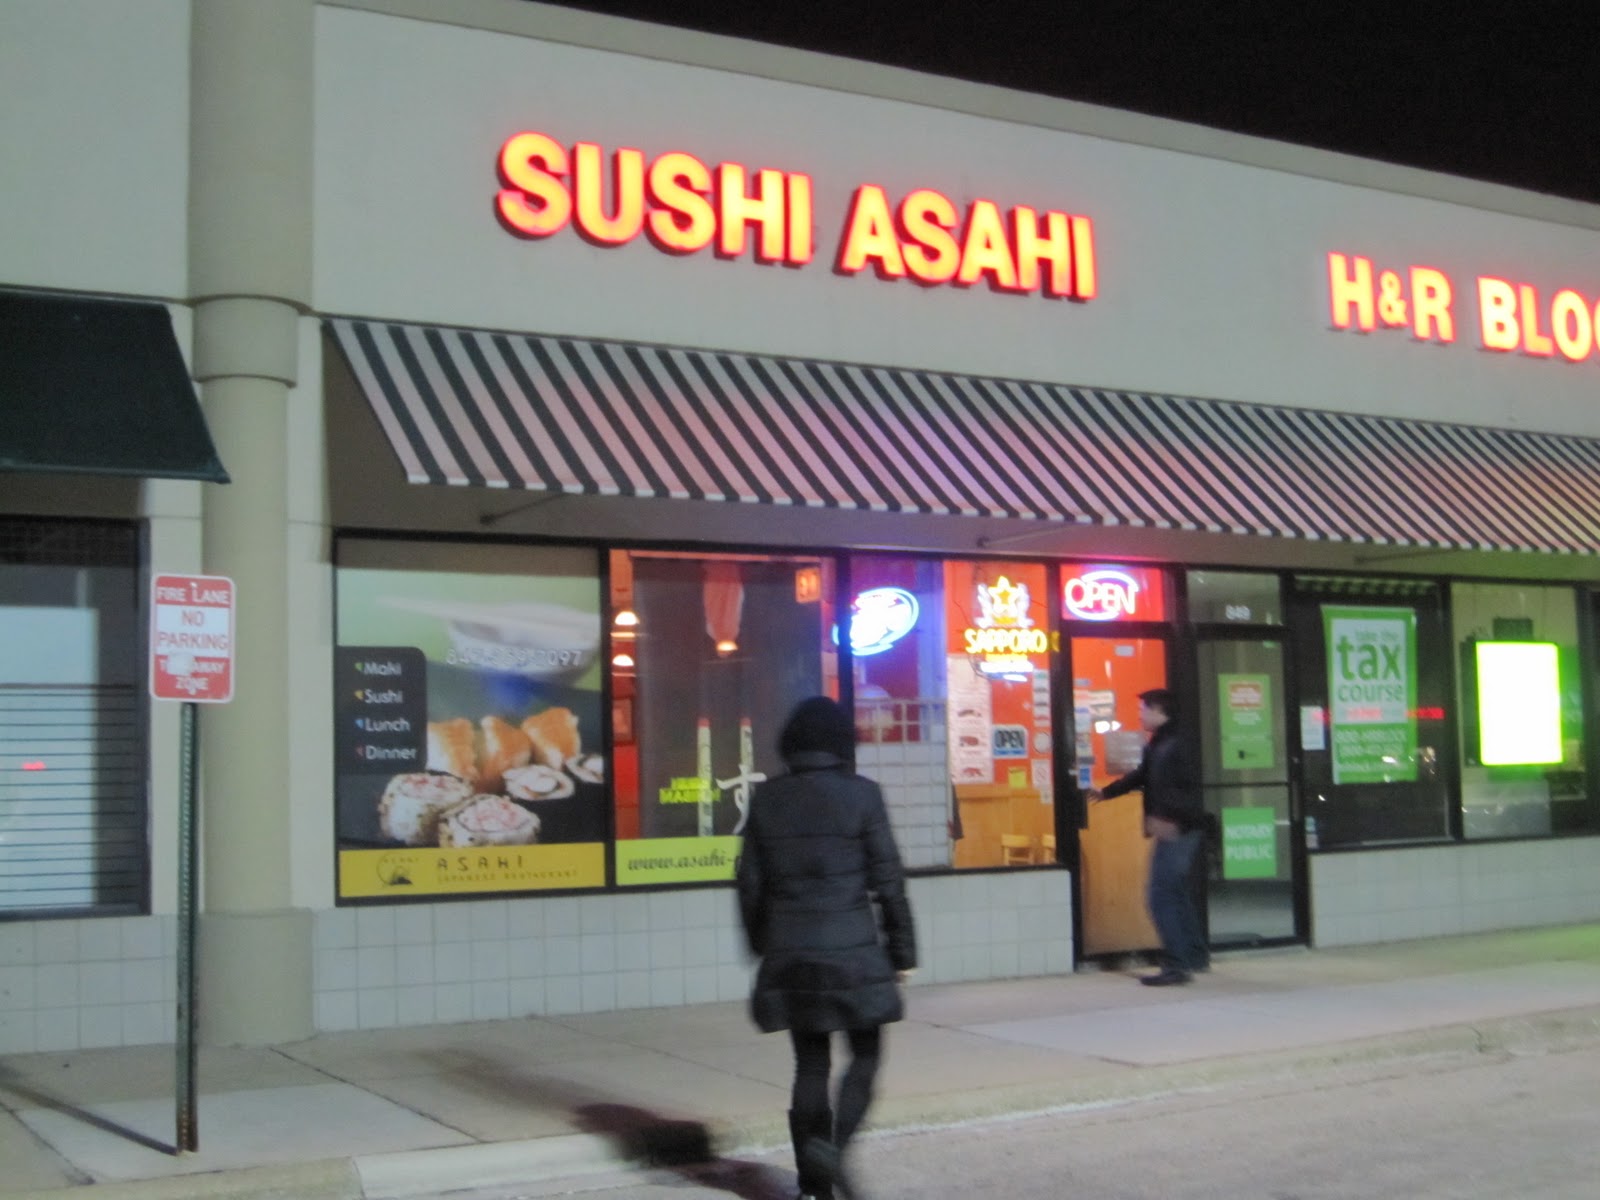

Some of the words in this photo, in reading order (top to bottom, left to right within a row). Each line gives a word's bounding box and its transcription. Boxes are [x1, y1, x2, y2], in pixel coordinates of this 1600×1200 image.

[496, 131, 814, 266] SUSHI
[836, 184, 1097, 300] ASAHI
[1327, 251, 1455, 343] H&R
[1476, 275, 1600, 362] BLO
[157, 586, 187, 602] FIRE
[191, 588, 230, 605] LANE
[1064, 578, 1136, 615] OPEN
[182, 610, 204, 627] NO
[159, 632, 228, 650] PARKING
[964, 628, 1047, 654] SAPPORO
[1336, 634, 1403, 681] tax
[364, 662, 402, 676] Maki
[364, 689, 403, 704] Sushi
[1338, 684, 1405, 703] course
[365, 717, 411, 733] Lunch
[365, 745, 417, 761] Dinner
[436, 855, 524, 872] ASAHI
